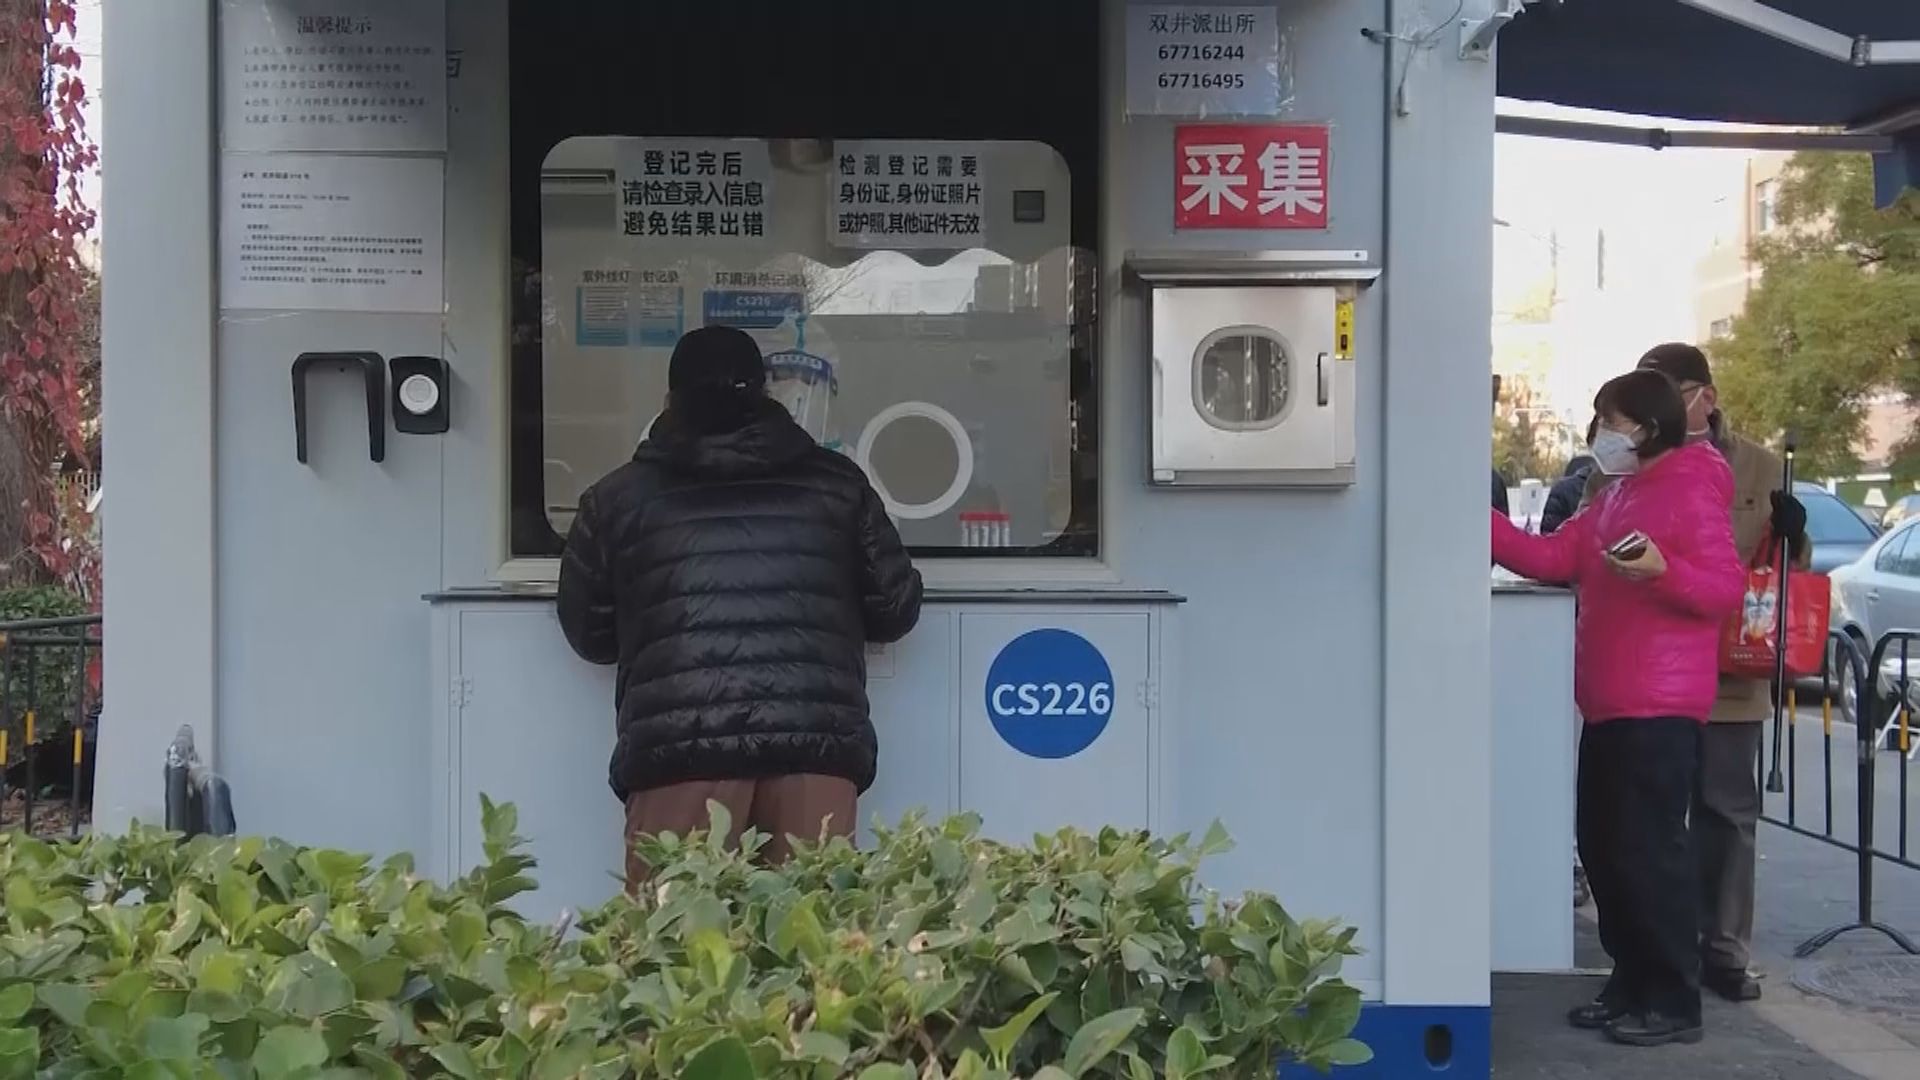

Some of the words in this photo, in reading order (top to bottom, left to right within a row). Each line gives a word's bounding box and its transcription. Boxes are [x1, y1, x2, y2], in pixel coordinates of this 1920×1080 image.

[297, 15, 372, 34] 温馨提示
[1149, 13, 1256, 35] 双井派出所
[1158, 45, 1245, 61] 67716244
[1158, 73, 1245, 89] 67716495
[643, 150, 742, 176] 登记完后
[839, 153, 977, 177] 检测登记需要
[1180, 141, 1325, 216] 采集
[622, 180, 764, 207] 请检查录入信息
[623, 211, 764, 237] 避免结果出错
[991, 682, 1111, 716] CS226
